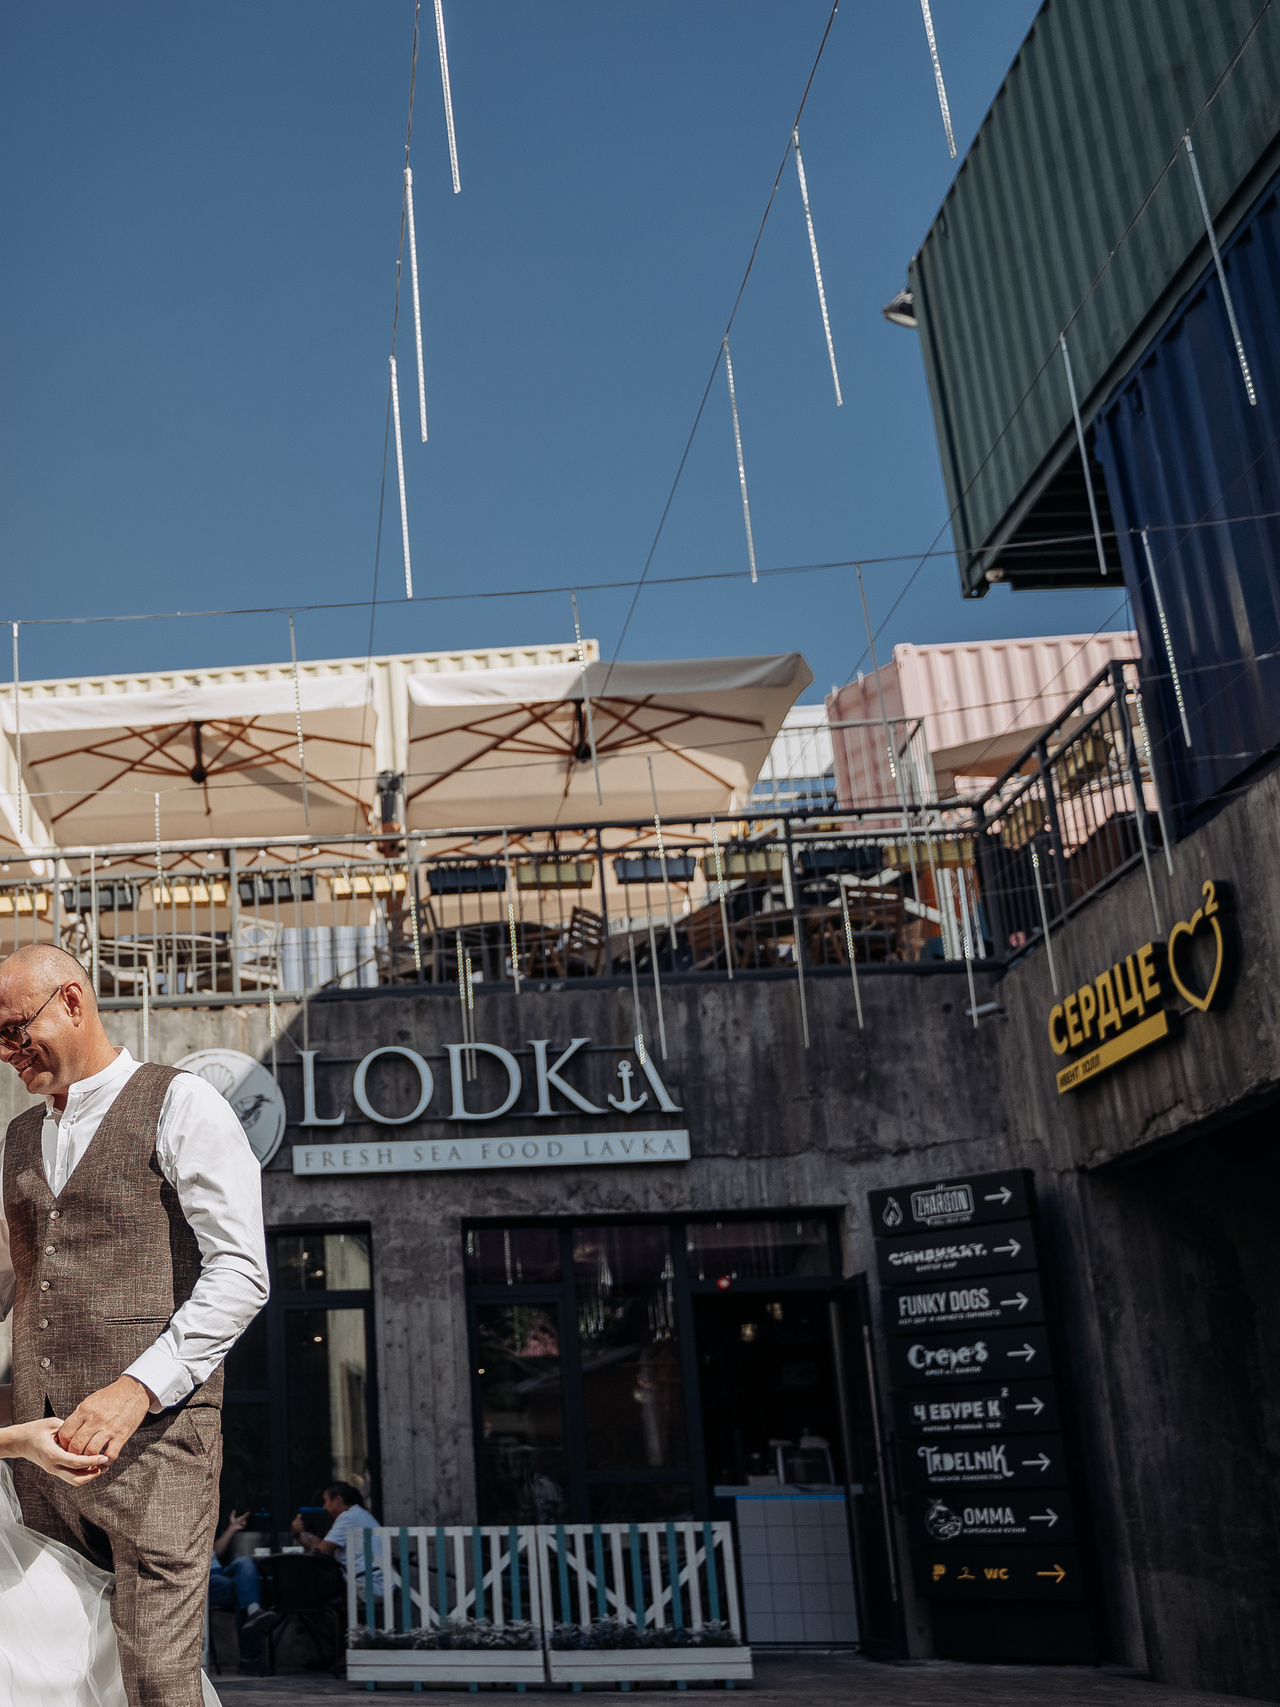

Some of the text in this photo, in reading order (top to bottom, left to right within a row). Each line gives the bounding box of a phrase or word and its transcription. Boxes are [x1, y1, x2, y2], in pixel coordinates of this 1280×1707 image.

[1048, 942, 1161, 1056] СЕРДЦЕ
[295, 1035, 684, 1127] LODKA
[304, 1137, 678, 1168] FRESH SEA FOOD LAVKA
[898, 1287, 991, 1318] FUNKY DOGS
[984, 1567, 1010, 1581] WC
